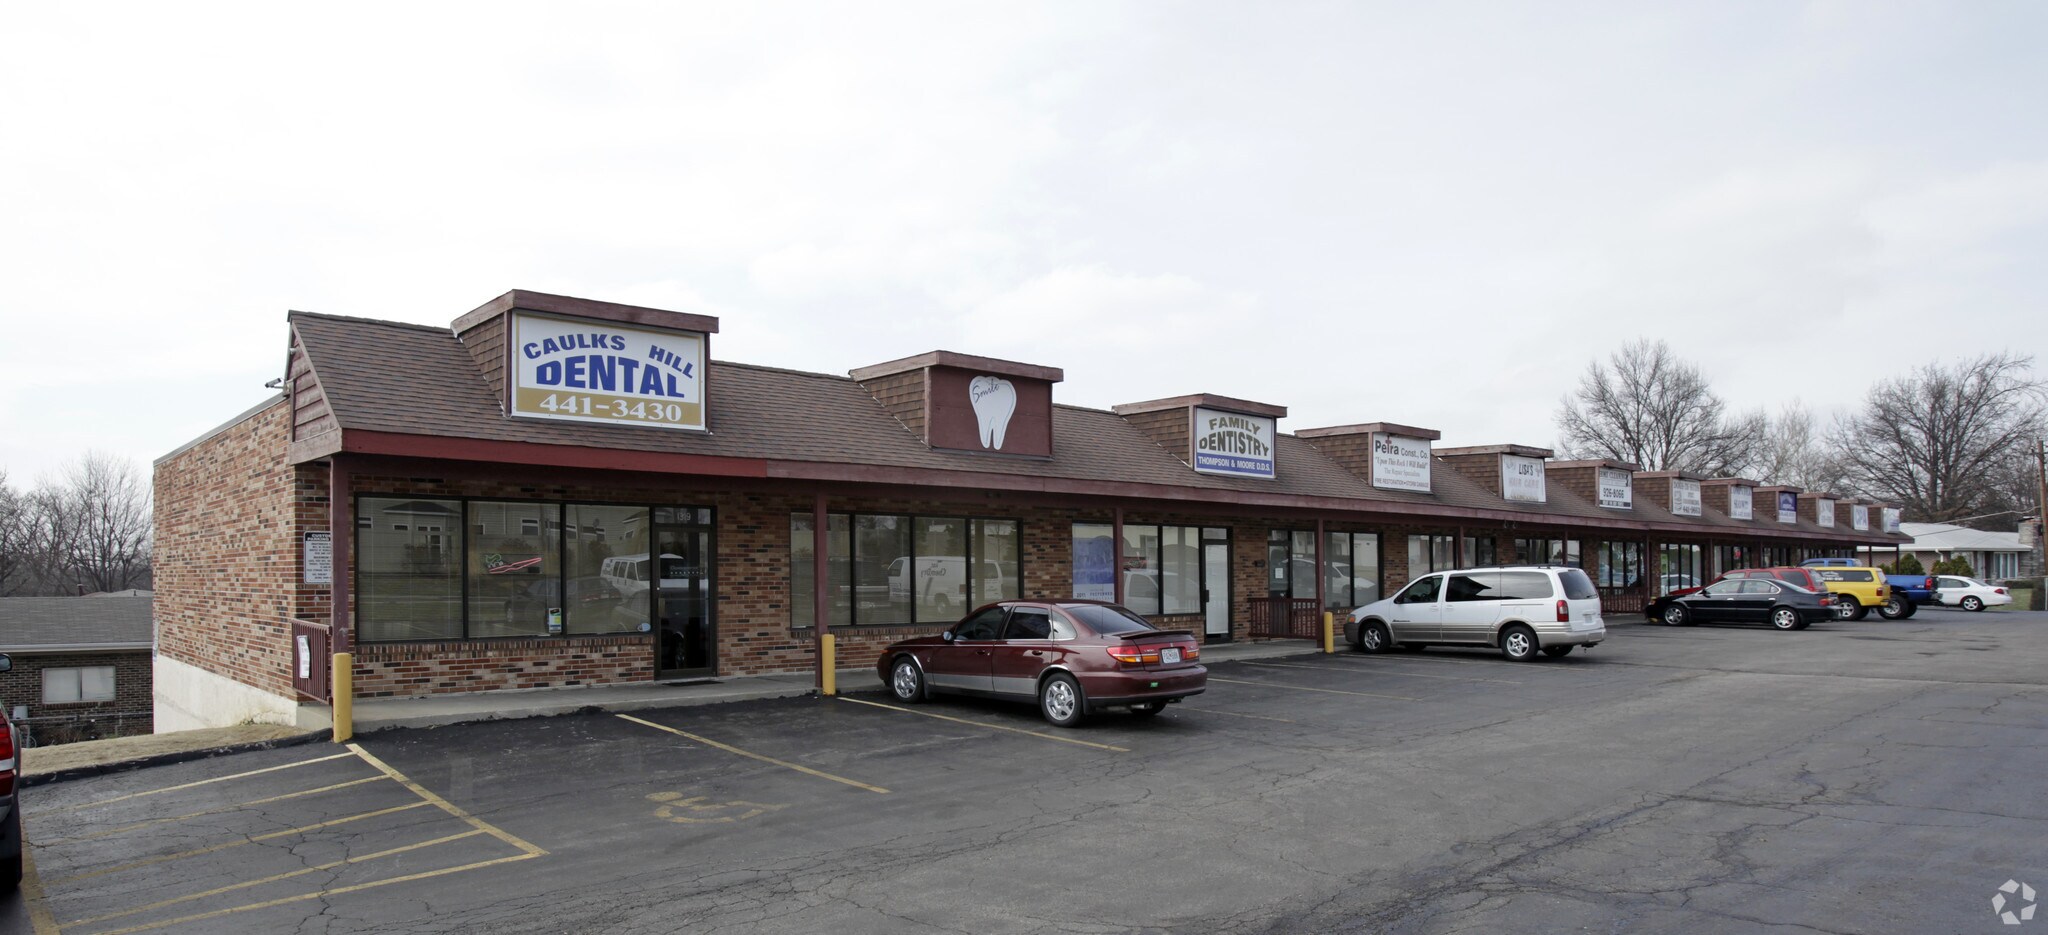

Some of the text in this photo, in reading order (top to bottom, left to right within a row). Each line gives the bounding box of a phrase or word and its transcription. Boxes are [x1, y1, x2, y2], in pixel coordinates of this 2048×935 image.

[523, 333, 694, 379] CAULKS HILL
[536, 354, 685, 399] DENTAL
[972, 378, 1000, 404] Smile
[539, 393, 682, 422] 441-3430
[1209, 417, 1260, 435] FAMILY
[1199, 431, 1269, 456] DENTISTRY
[1375, 437, 1399, 455] Petra
[1420, 450, 1429, 459] Co.
[1198, 456, 1230, 467] THOMPSON
[1230, 459, 1236, 468] &
[1236, 460, 1256, 470] MOORE
[1518, 463, 1534, 476] LISA'S
